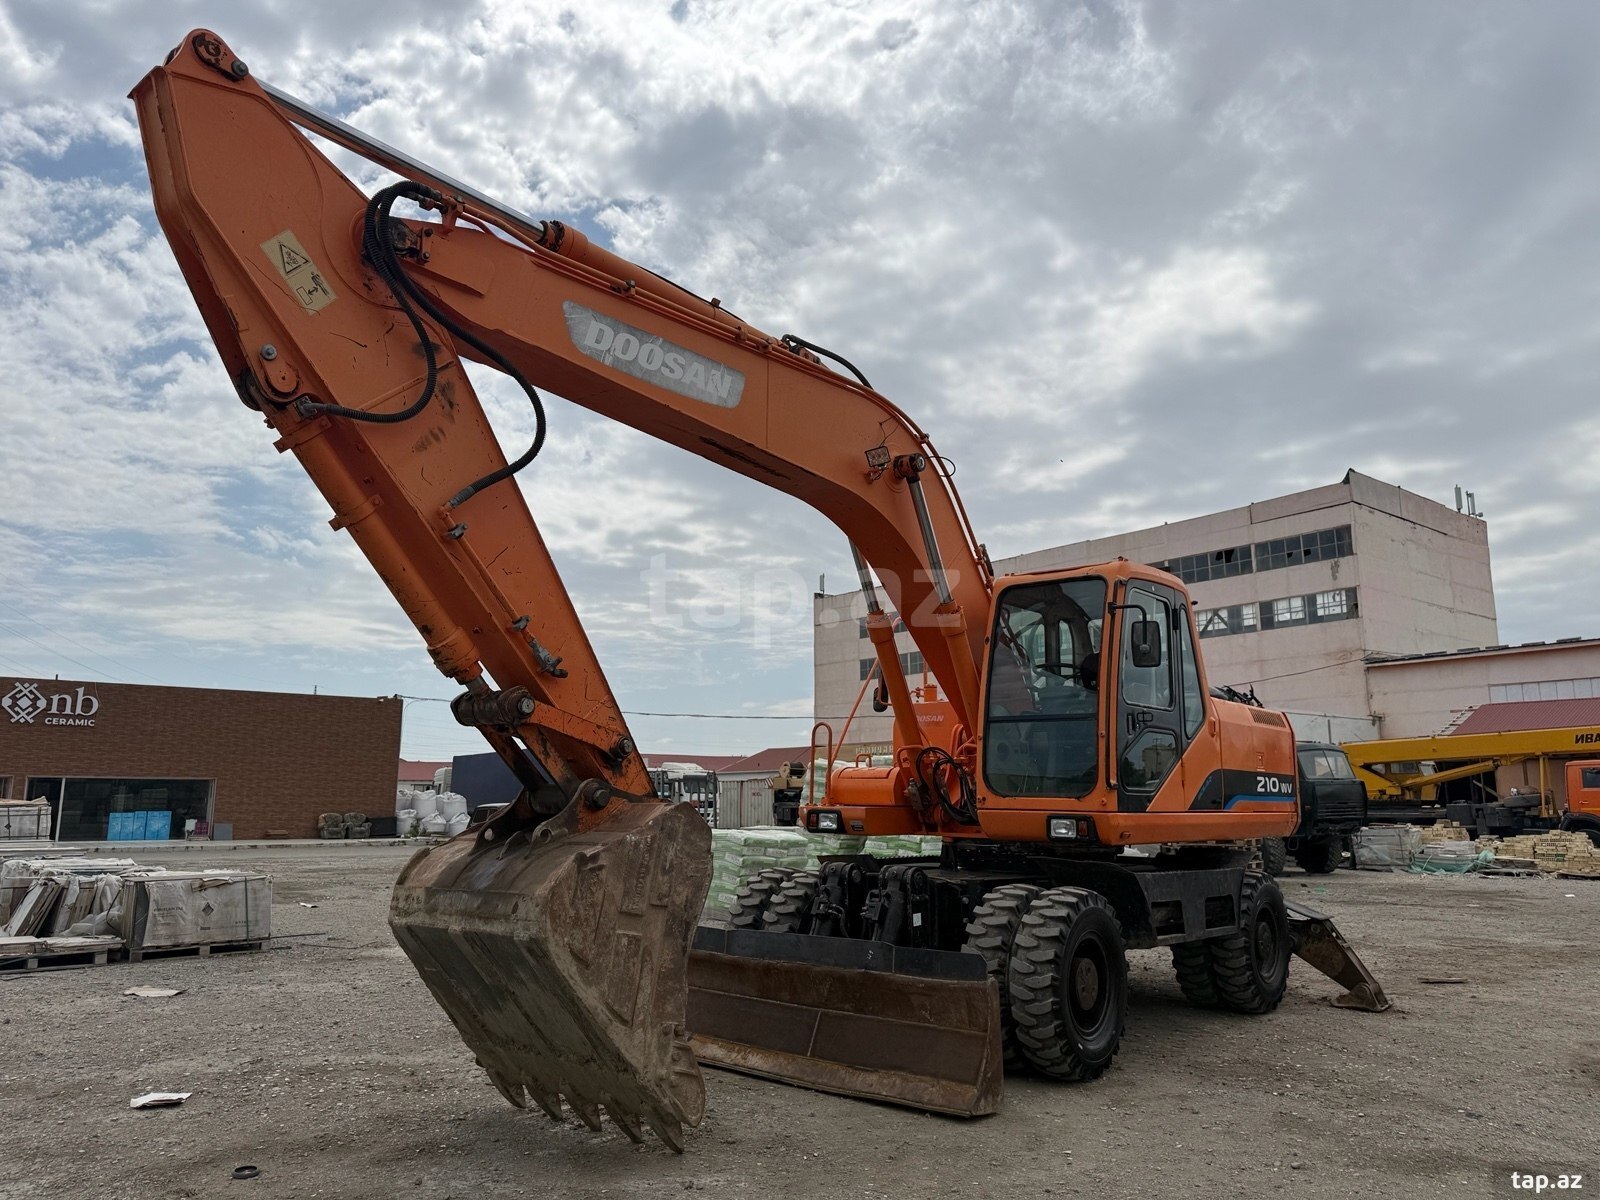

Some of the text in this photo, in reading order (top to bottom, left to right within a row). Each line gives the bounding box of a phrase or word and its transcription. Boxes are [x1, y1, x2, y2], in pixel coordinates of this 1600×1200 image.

[584, 320, 732, 398] DOOSAN
[47, 686, 99, 716] nb
[44, 717, 96, 727] CERAMIC
[1256, 776, 1279, 793] 210
